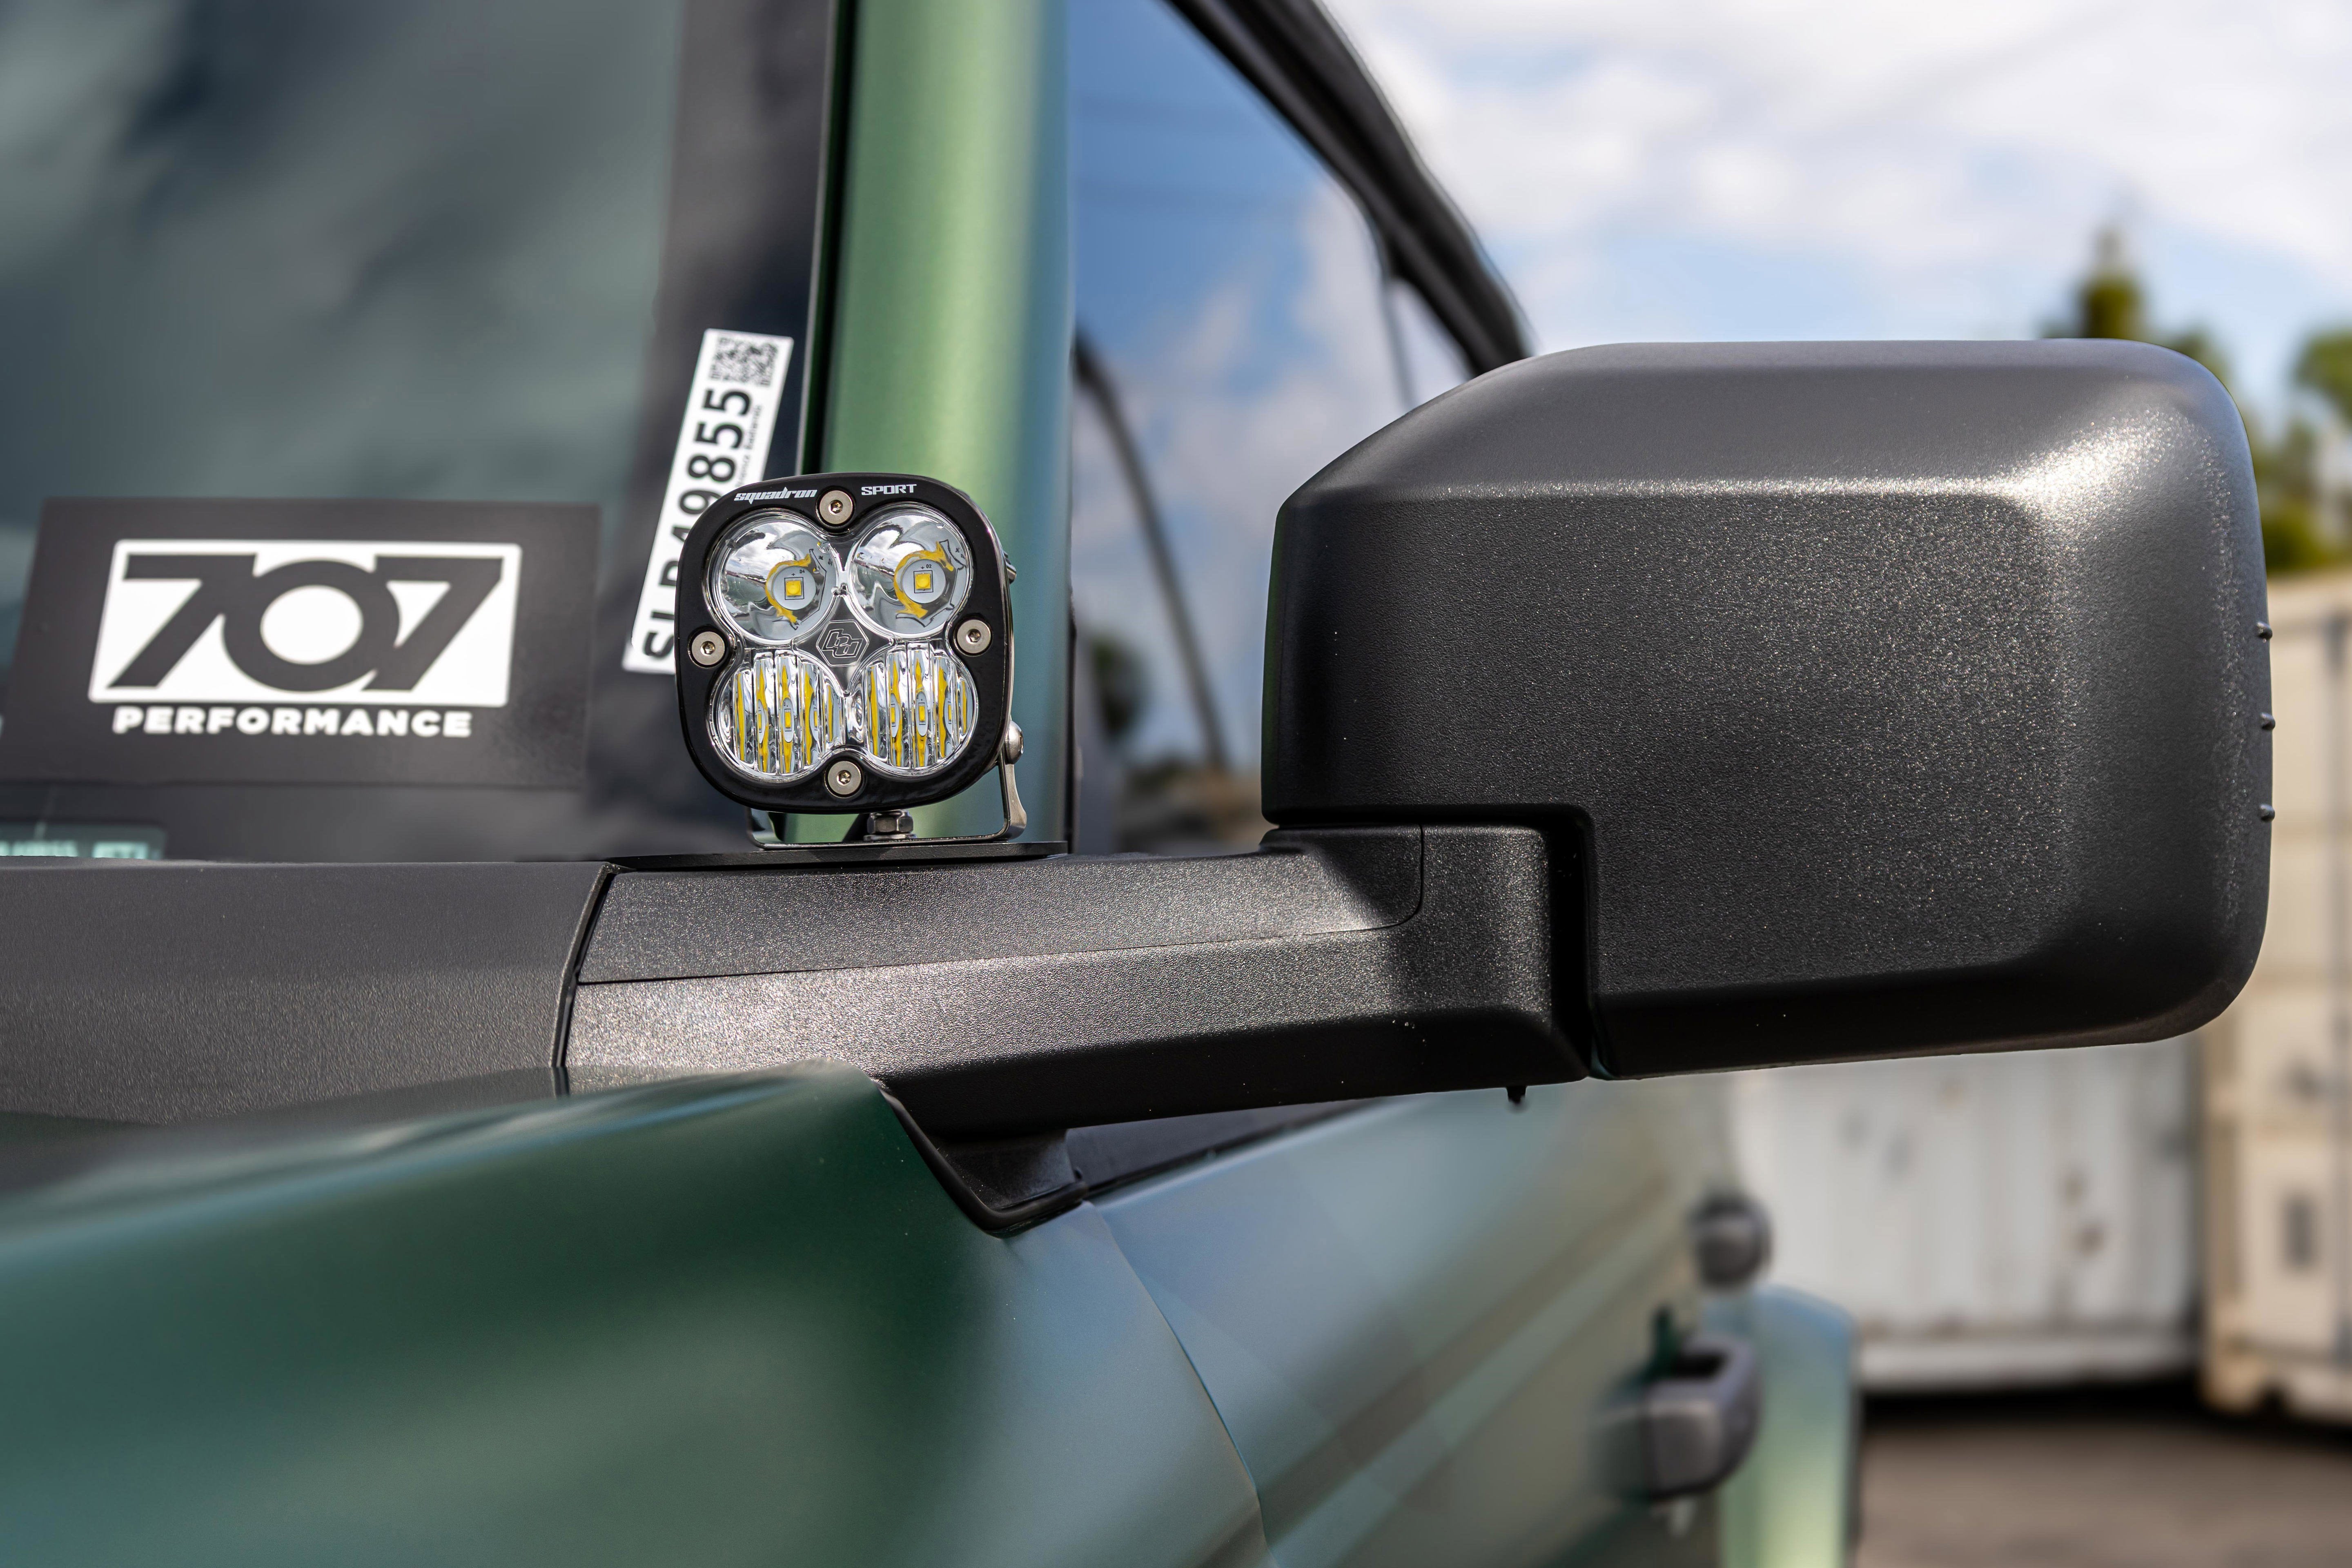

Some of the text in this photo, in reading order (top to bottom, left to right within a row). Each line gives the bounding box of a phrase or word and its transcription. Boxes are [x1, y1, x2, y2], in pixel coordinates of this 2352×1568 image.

[734, 484, 917, 504] squadron SPORT
[107, 552, 504, 693] 707
[112, 706, 472, 737] PERFORMANCE
